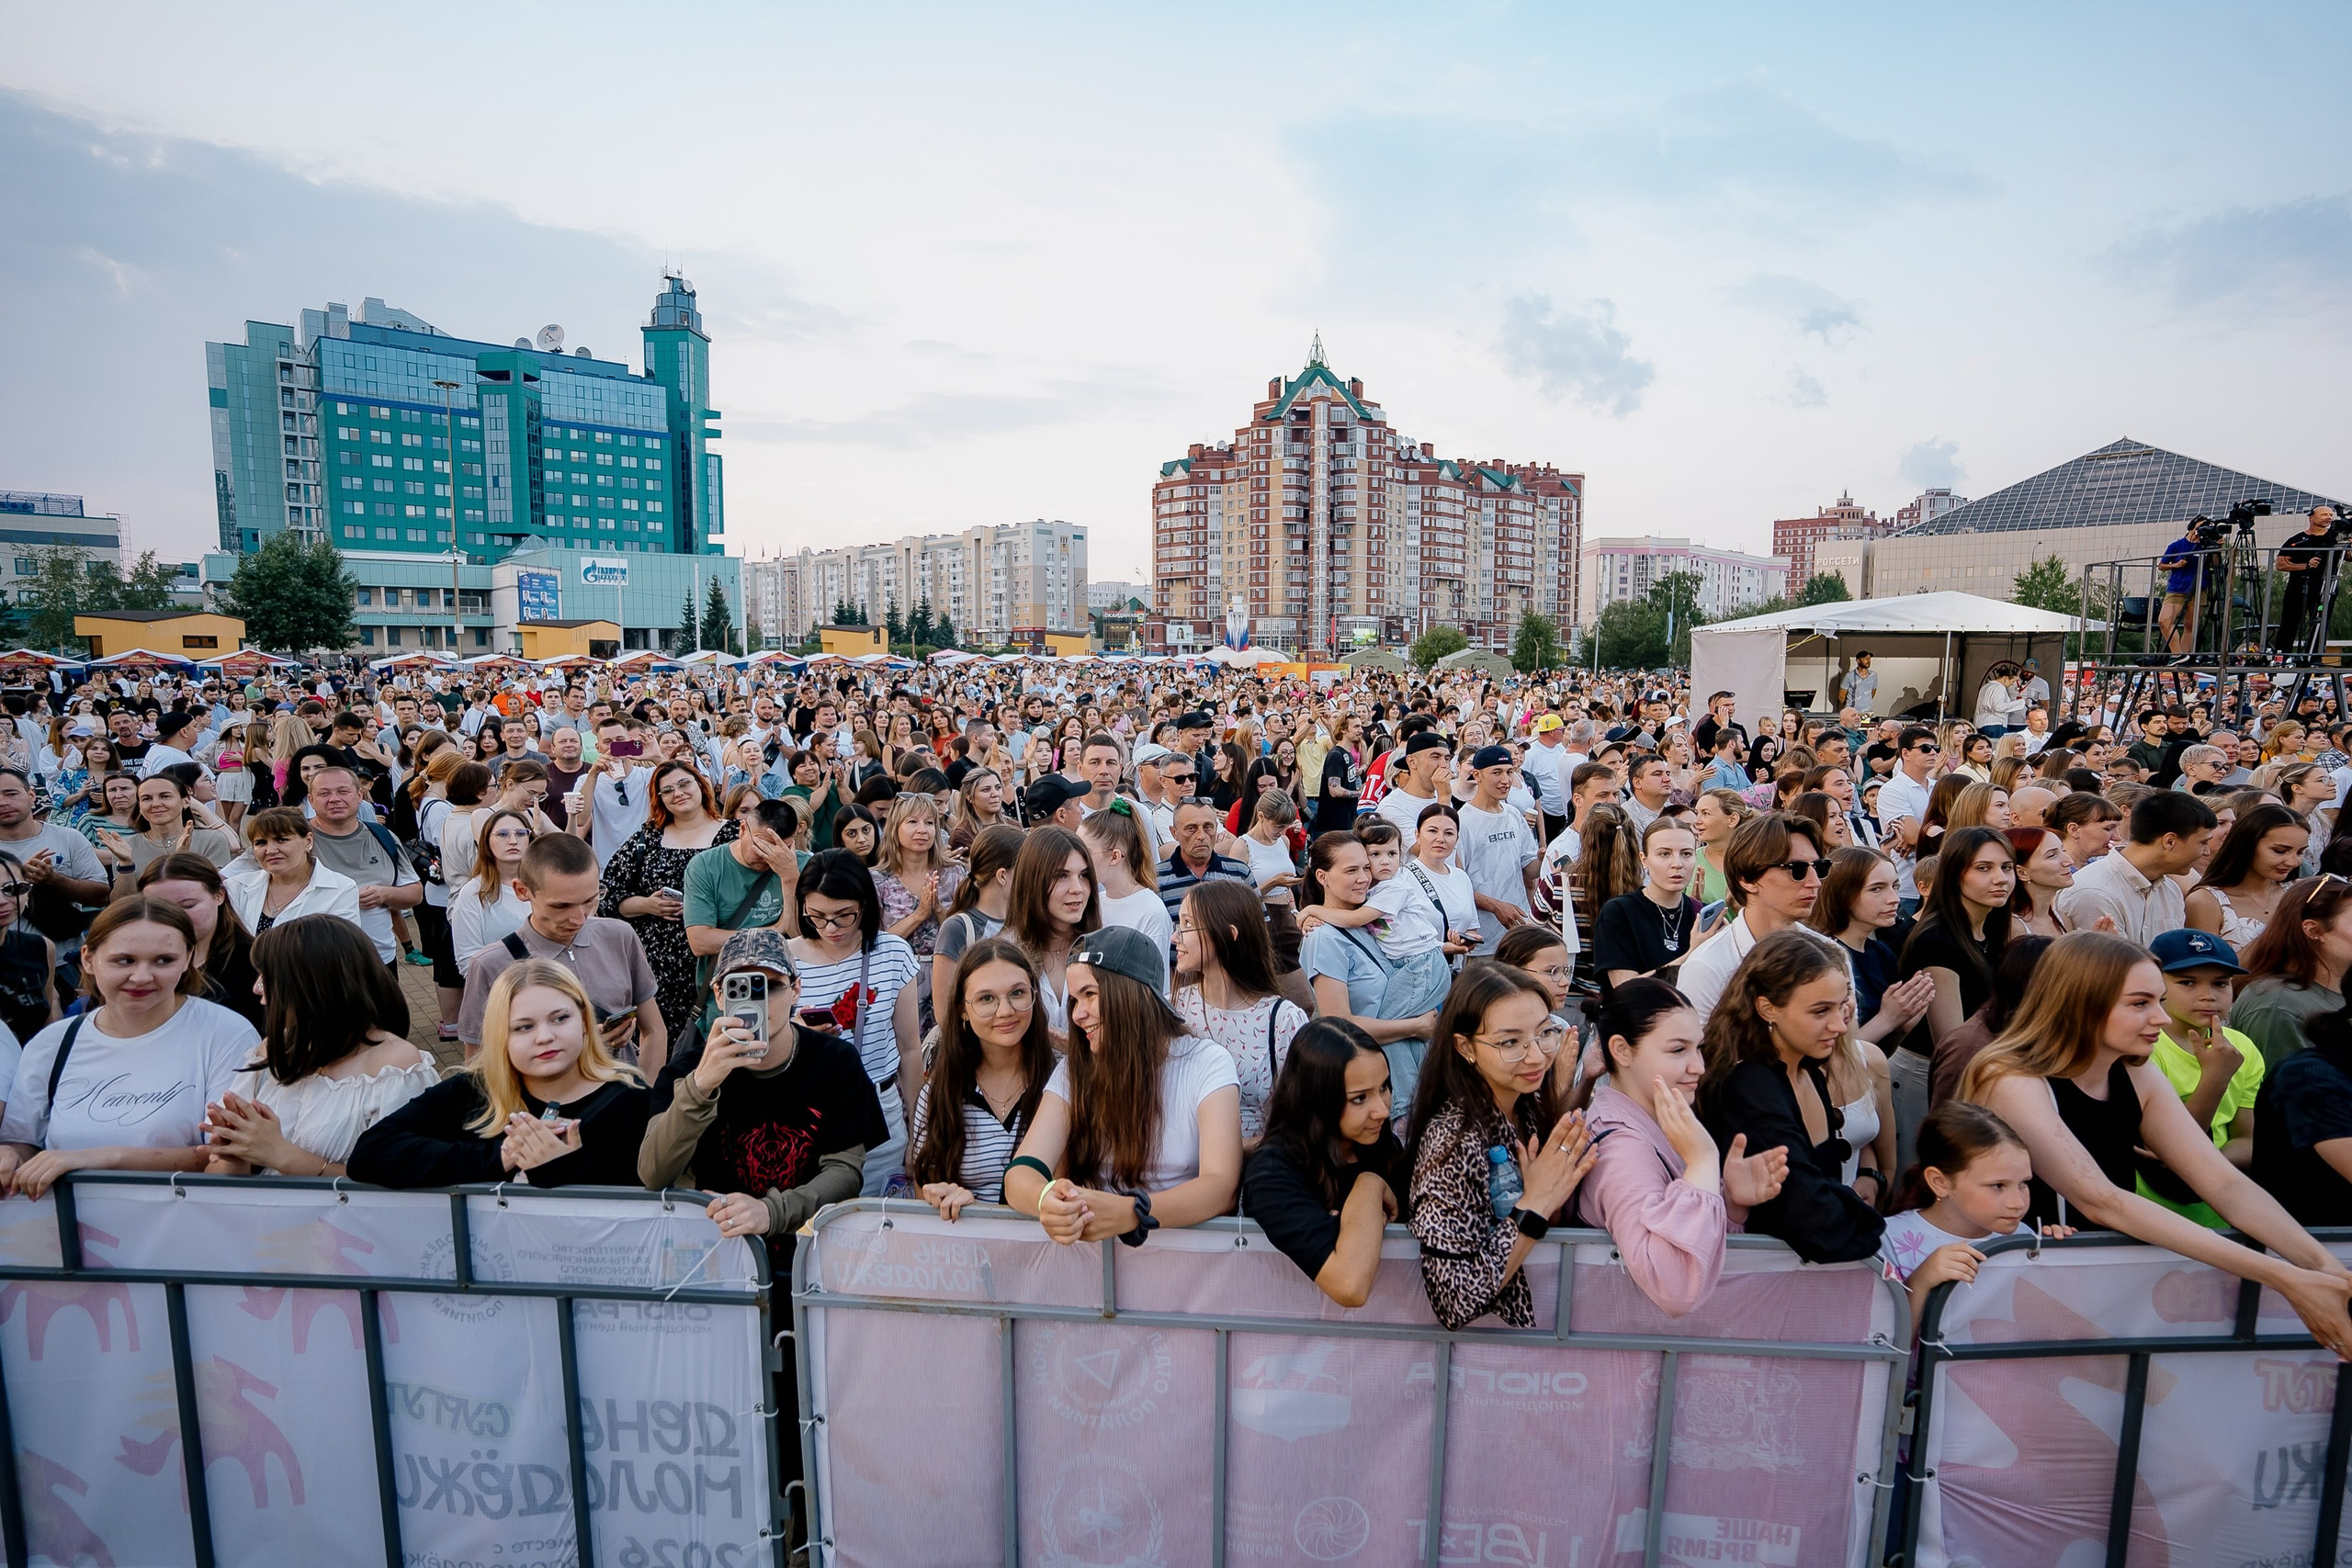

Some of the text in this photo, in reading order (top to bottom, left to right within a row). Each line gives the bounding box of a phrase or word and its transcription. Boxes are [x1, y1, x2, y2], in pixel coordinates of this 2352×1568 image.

[1816, 556, 1860, 567] РОССЕТИ
[597, 567, 627, 576] ГАЗПРОМ
[1413, 868, 1428, 884] NICE
[55, 1073, 197, 1126] Heavenly
